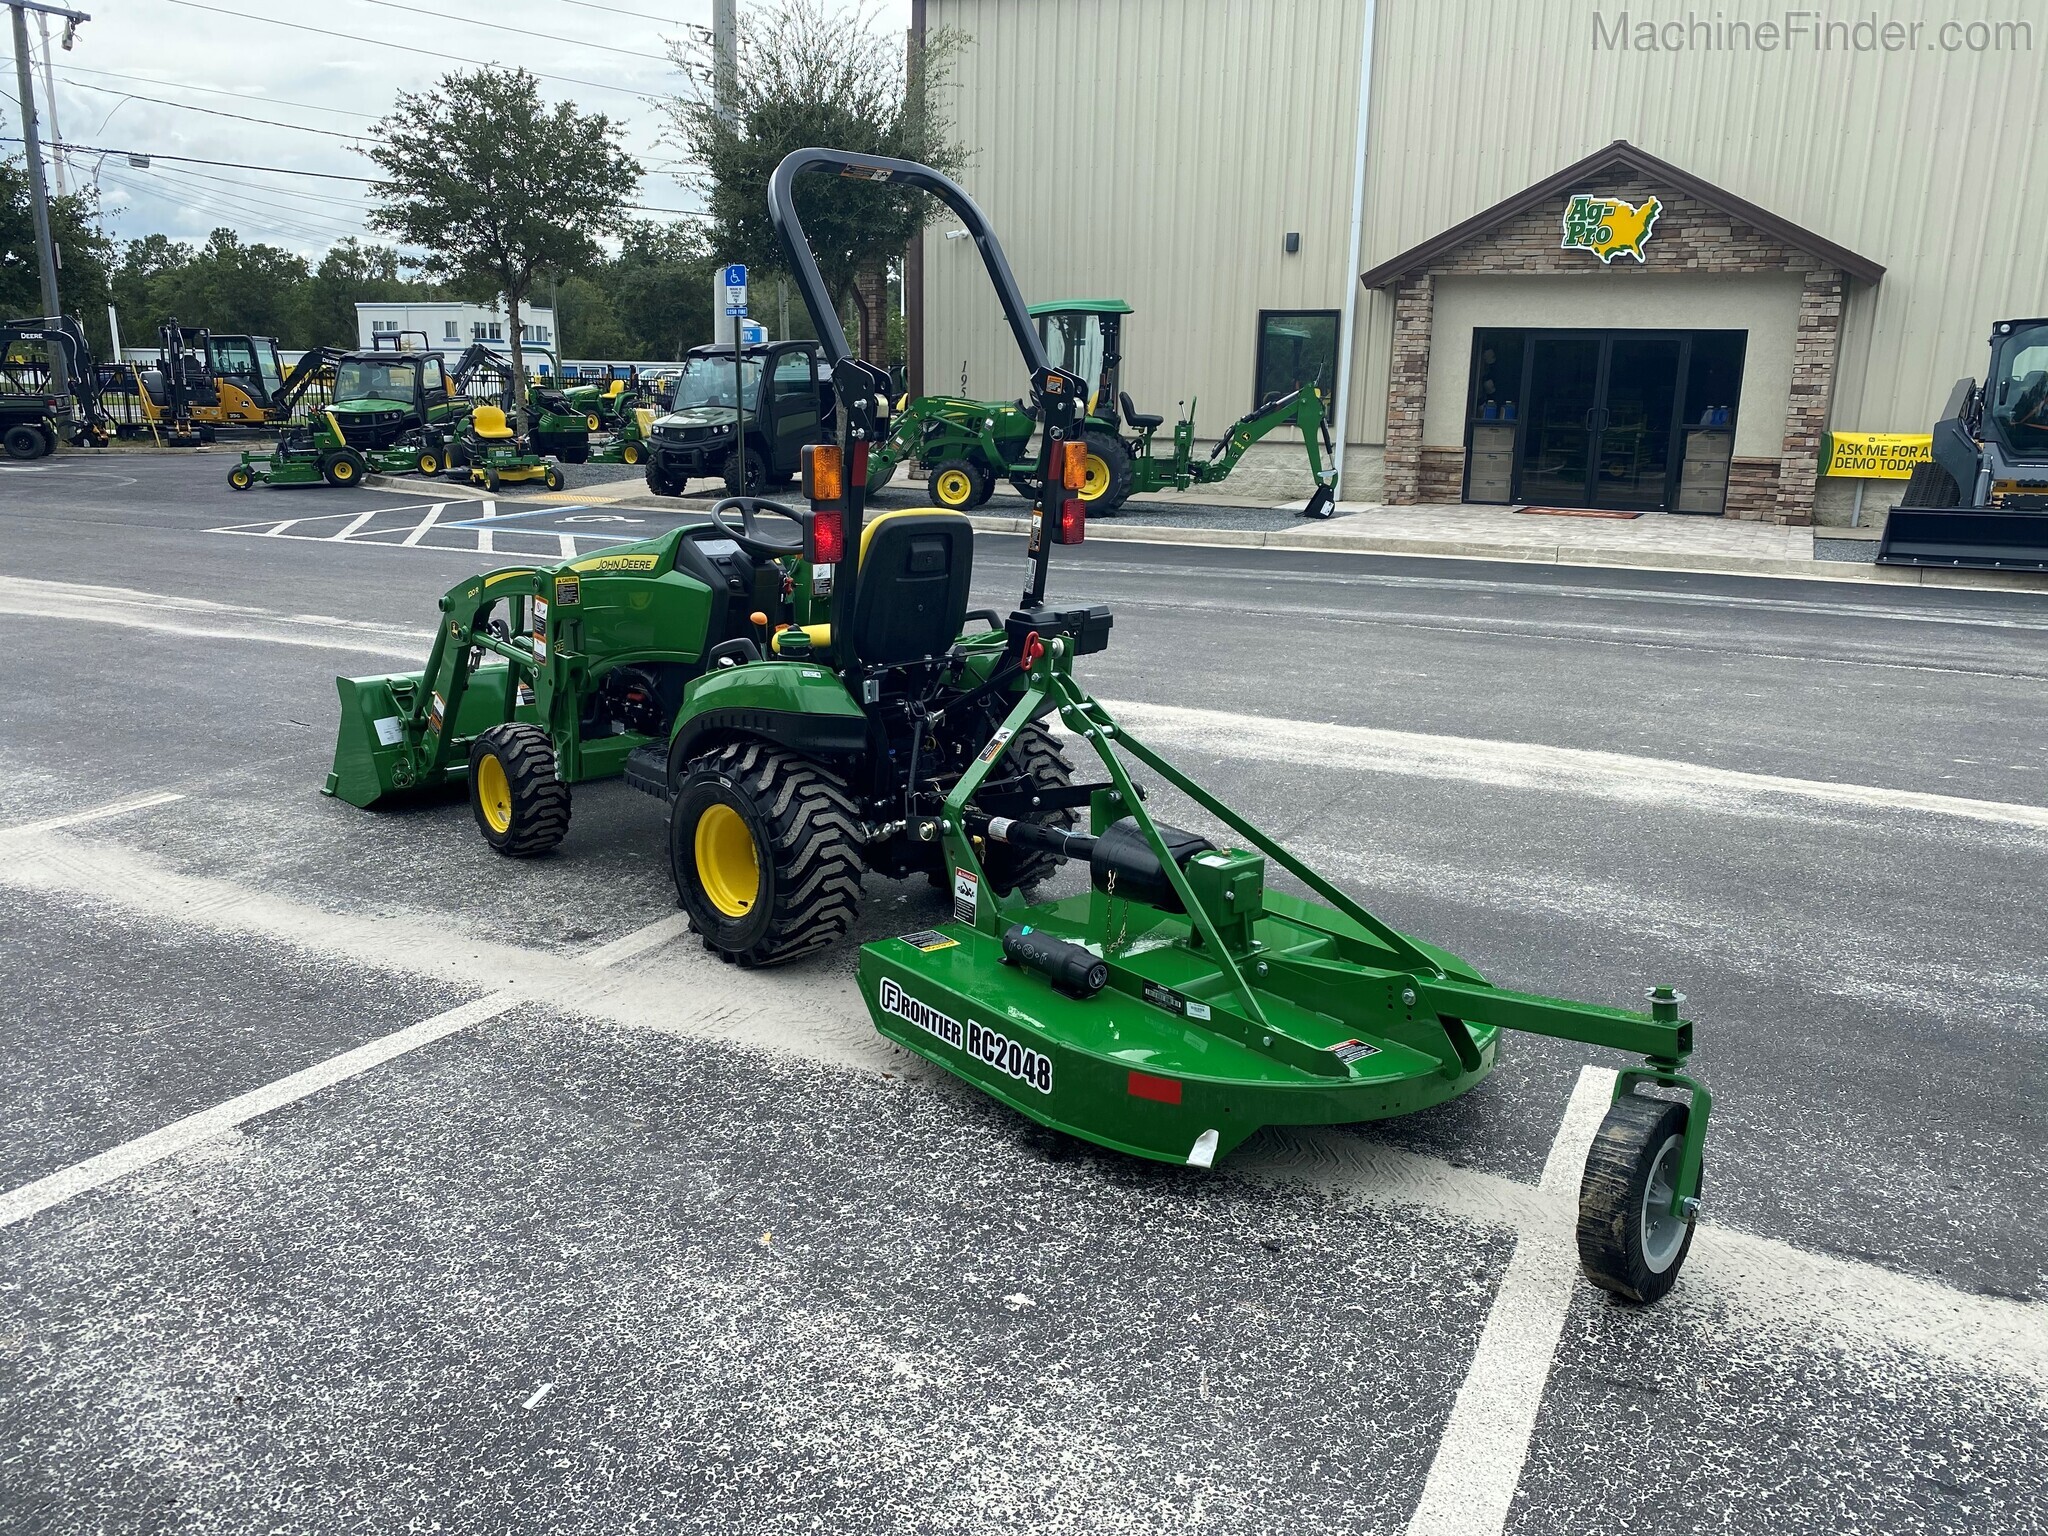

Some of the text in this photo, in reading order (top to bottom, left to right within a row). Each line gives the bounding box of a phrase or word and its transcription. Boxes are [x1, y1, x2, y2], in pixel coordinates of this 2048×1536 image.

[1567, 198, 1615, 225] Ag-
[1564, 221, 1612, 245] Pro
[1837, 443, 1929, 458] ASK ME FOR A
[1834, 457, 1876, 469] DEMO
[596, 558, 652, 571] JOHN DEERE
[880, 978, 1051, 1092] FRONTIER RC2048
